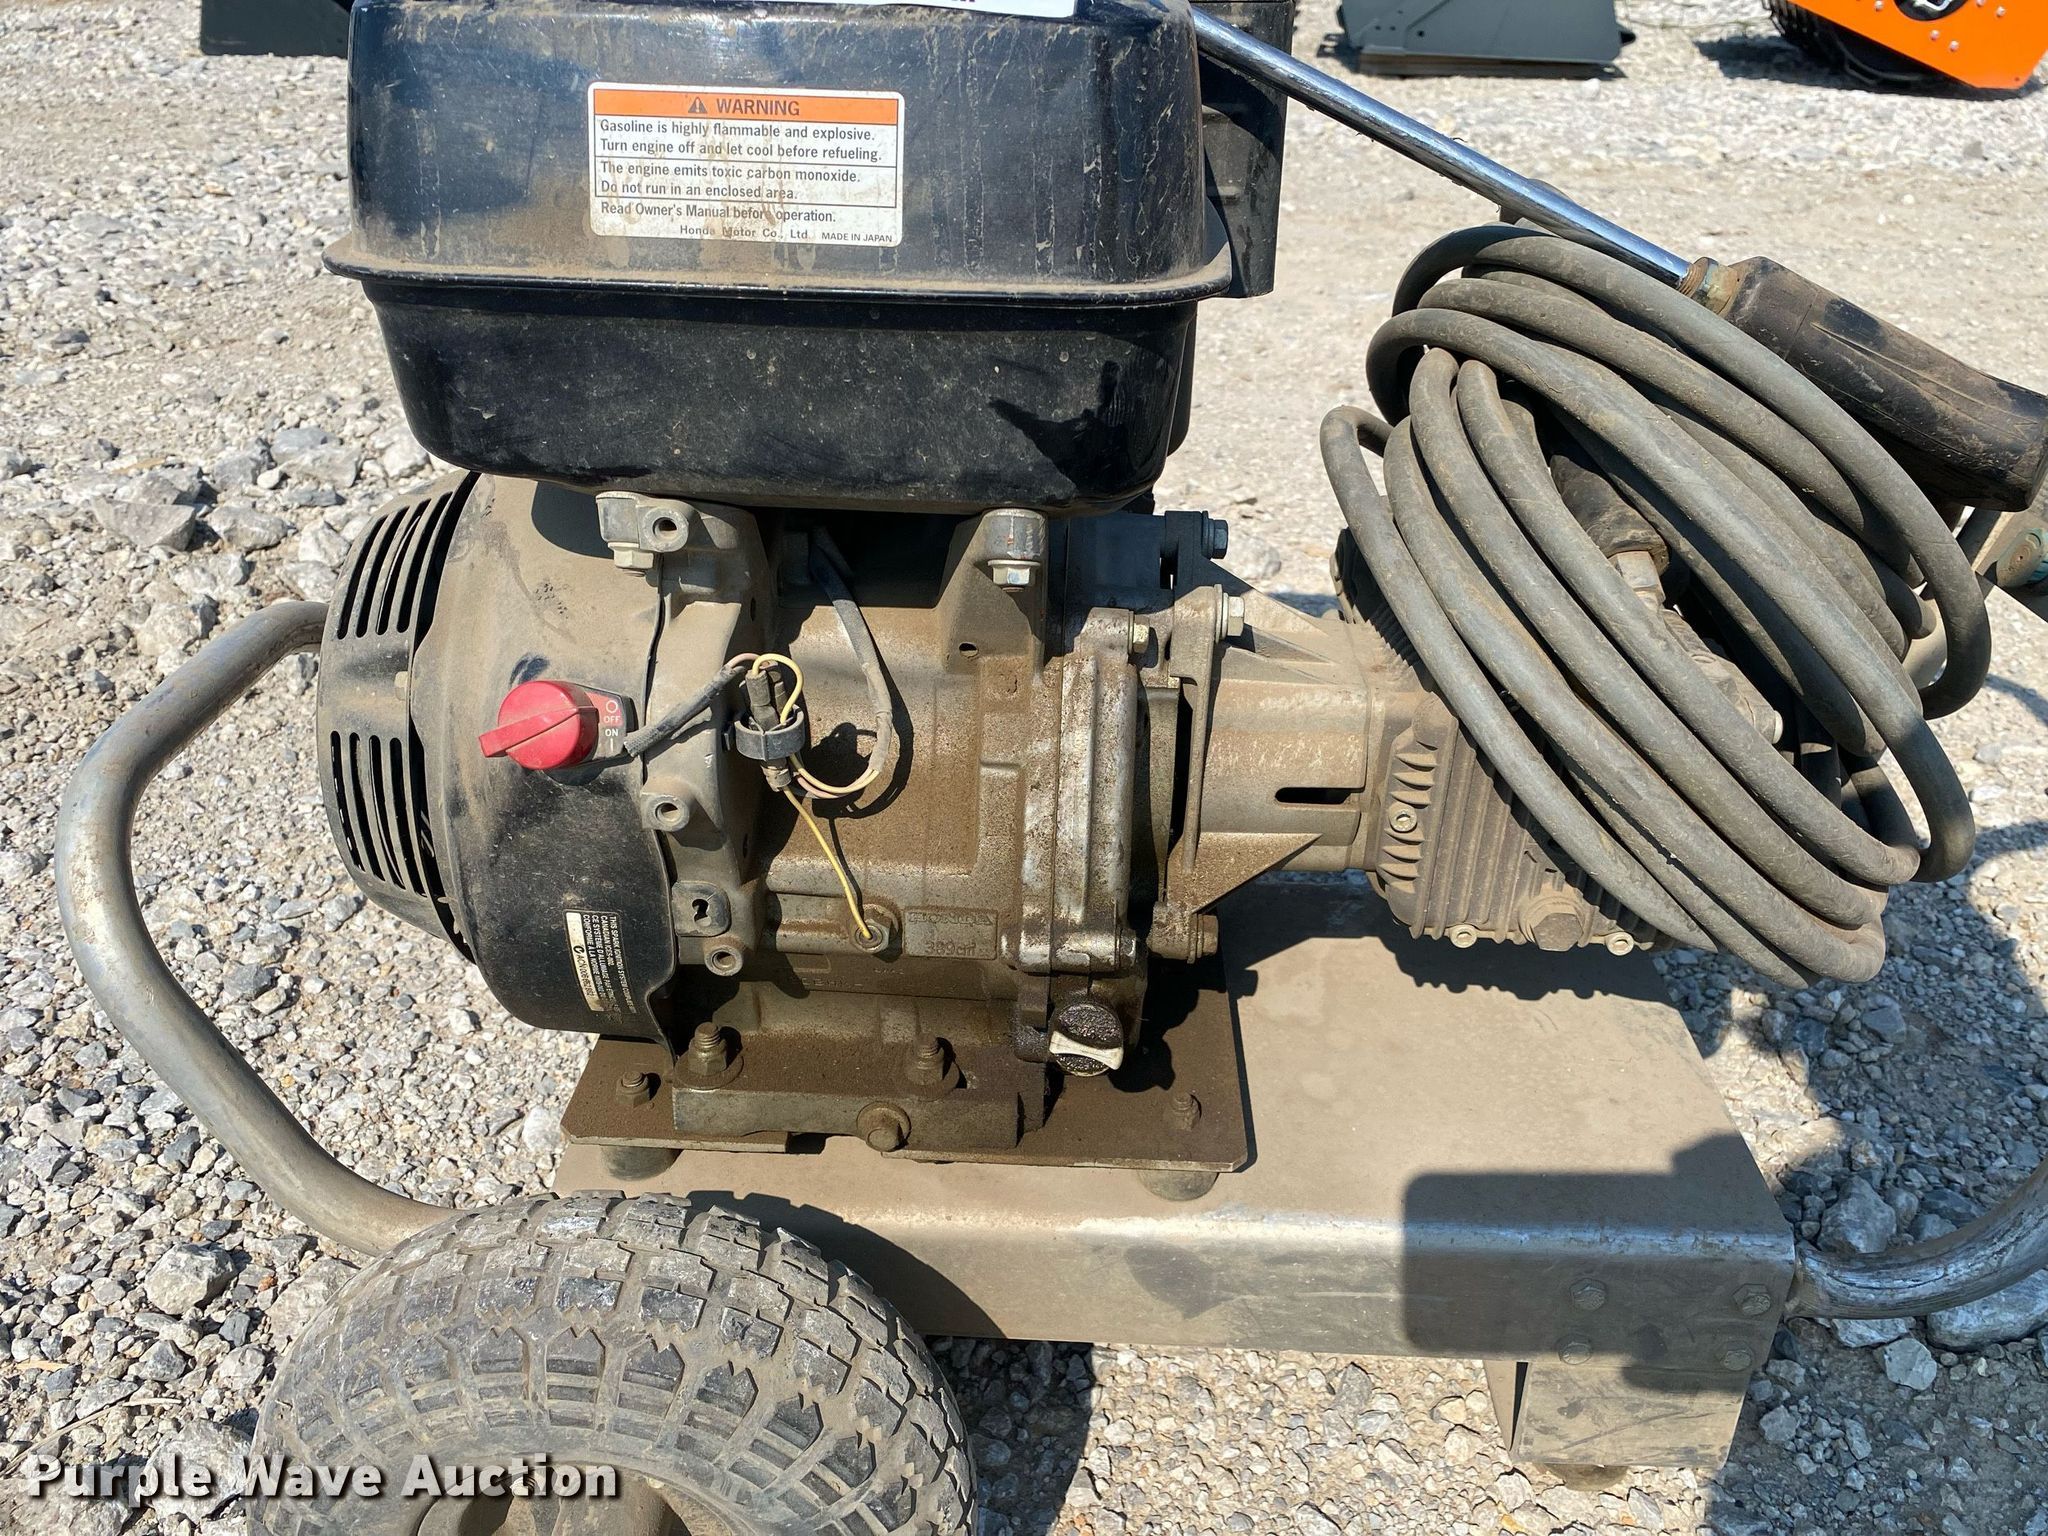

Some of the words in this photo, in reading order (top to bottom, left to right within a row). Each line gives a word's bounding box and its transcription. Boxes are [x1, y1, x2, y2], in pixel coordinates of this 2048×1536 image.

[717, 98, 800, 116] WARNING
[600, 119, 653, 132] Gasoline
[657, 121, 667, 133] is
[672, 121, 709, 137] highly
[713, 123, 780, 137] flammable
[785, 126, 808, 138] and
[813, 126, 875, 141] explosive.
[601, 138, 627, 151] Turn
[632, 140, 673, 154] engine
[679, 141, 695, 153] off
[700, 143, 722, 154] and
[727, 143, 742, 155] let
[747, 144, 773, 156] cool
[778, 144, 818, 157] before
[823, 146, 882, 162] refueling.
[601, 161, 623, 173] The
[628, 163, 669, 177] engine
[674, 164, 708, 177] emits
[712, 166, 742, 177] toxic
[747, 166, 790, 180] carbon
[795, 169, 861, 182] monoxide.
[601, 180, 617, 192] Do
[622, 183, 642, 193] not
[646, 184, 666, 194] run
[671, 183, 681, 195] in
[686, 186, 701, 195] an
[705, 185, 761, 197] enclosed
[766, 189, 798, 199] area.
[601, 202, 632, 214] Read
[635, 203, 682, 216] Owner's
[686, 204, 729, 218] Manual
[776, 208, 836, 222] operation.
[680, 225, 716, 235] Honda
[722, 227, 756, 237] Motor
[821, 232, 848, 240] MADE
[863, 234, 892, 242] JAPAN
[592, 915, 599, 923] CE
[600, 915, 610, 944] CANADIAN
[611, 930, 621, 948] SPARK
